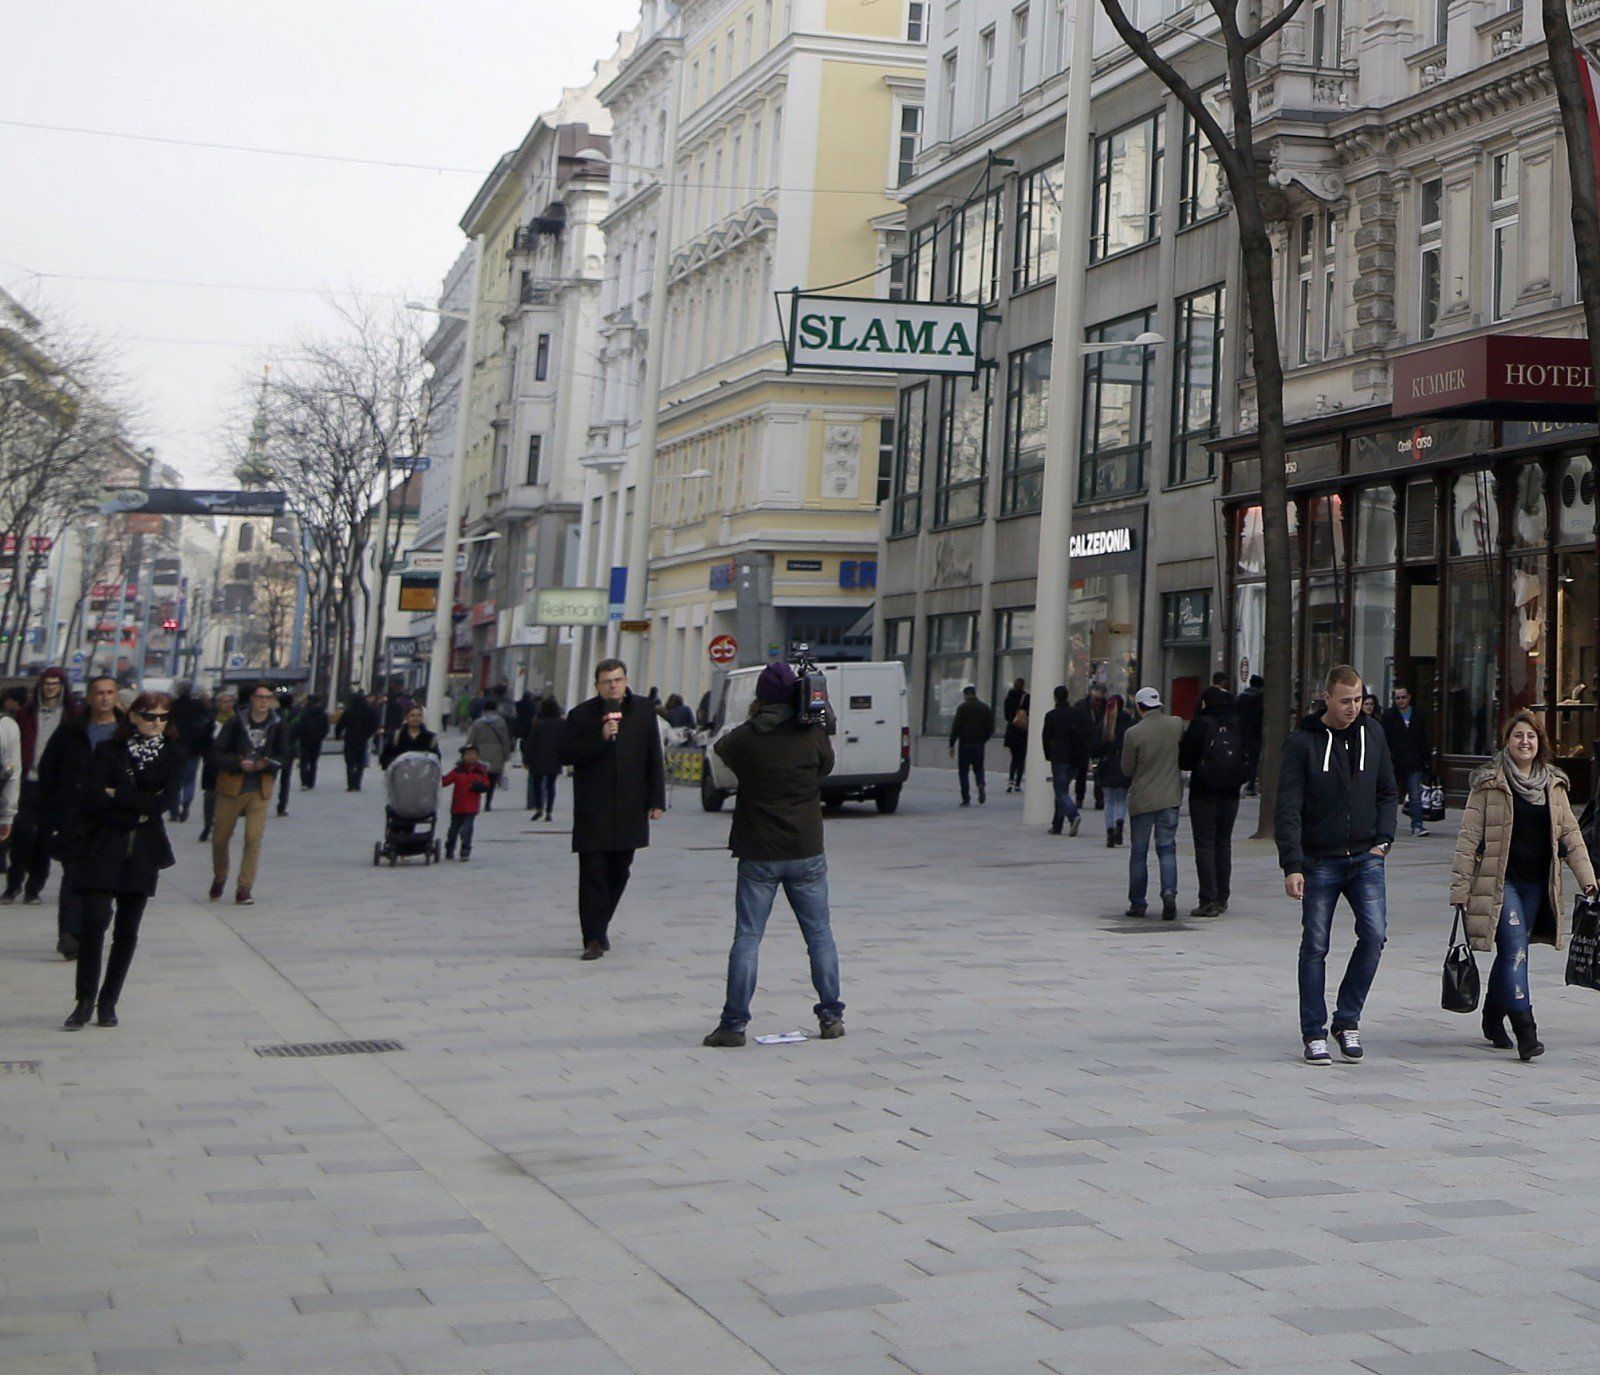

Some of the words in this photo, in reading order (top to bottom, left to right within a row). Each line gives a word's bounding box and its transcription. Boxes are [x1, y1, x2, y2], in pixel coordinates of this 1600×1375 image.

[798, 313, 975, 357] SLAMA
[1412, 367, 1466, 399] KUMMER
[1504, 363, 1594, 388] HOTEL
[1069, 527, 1131, 557] CALZEDONIA
